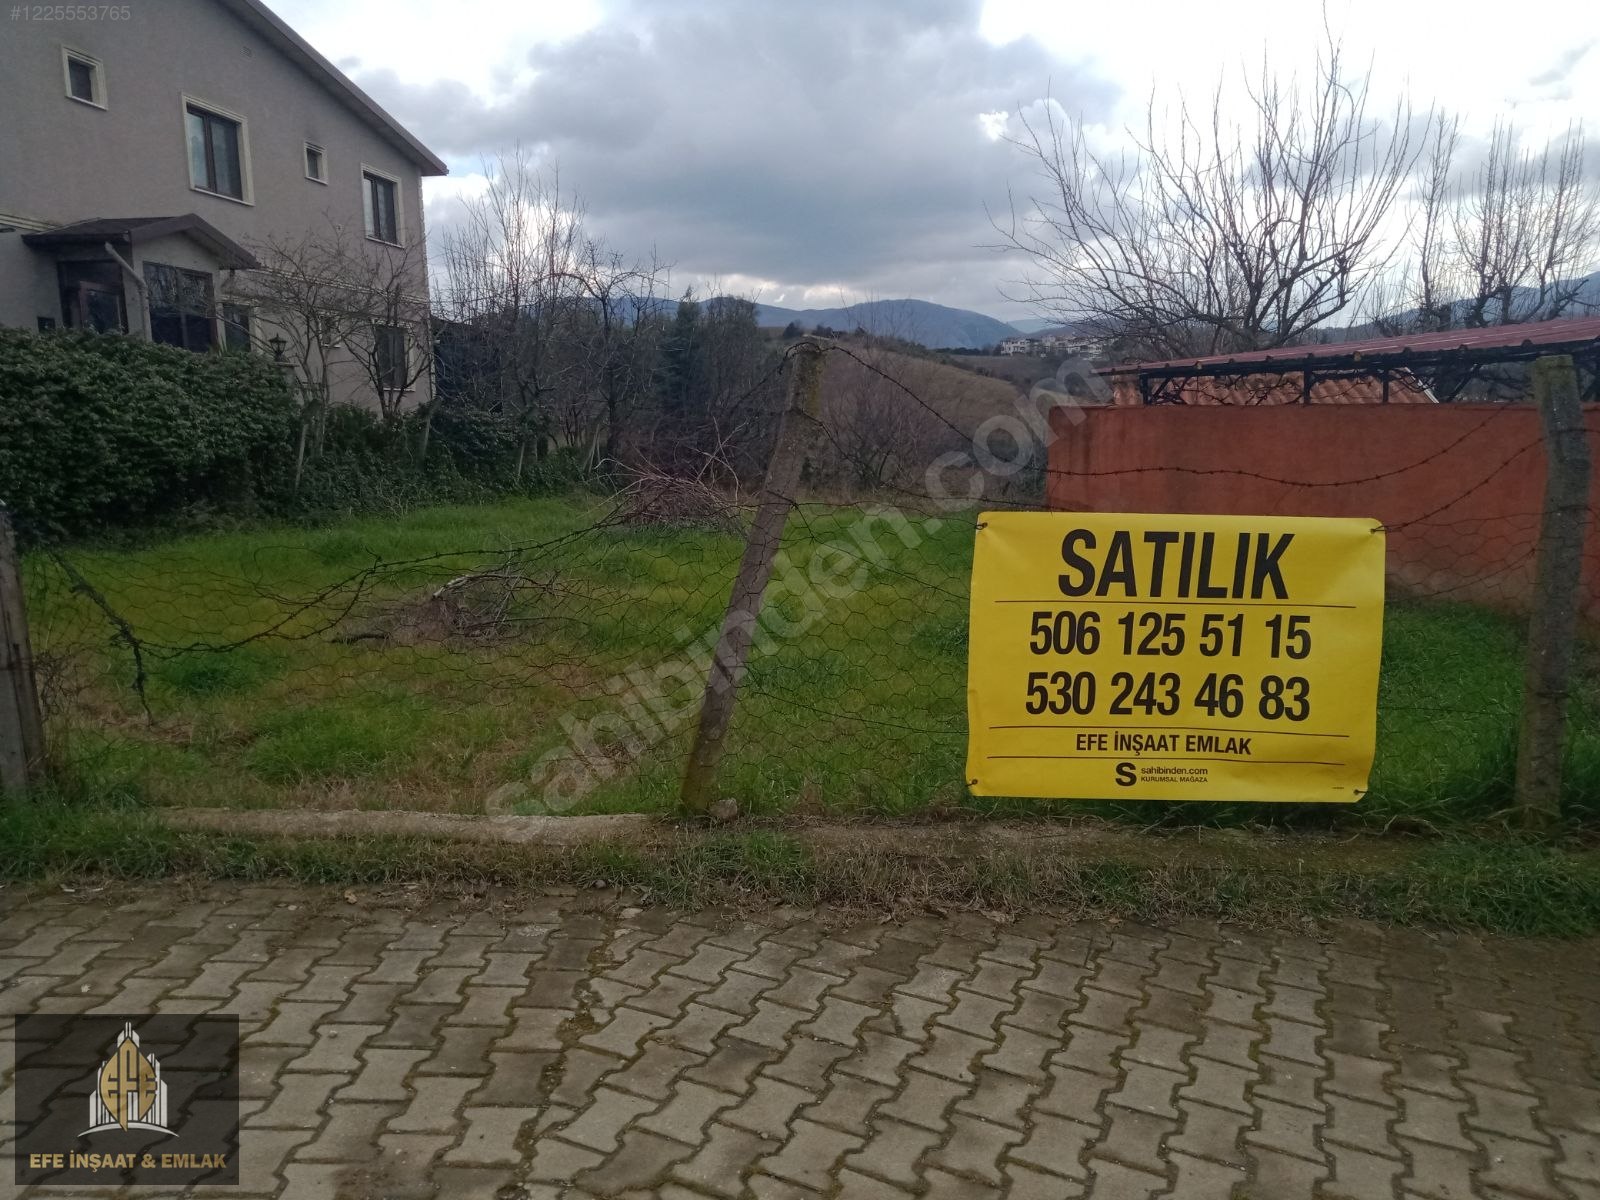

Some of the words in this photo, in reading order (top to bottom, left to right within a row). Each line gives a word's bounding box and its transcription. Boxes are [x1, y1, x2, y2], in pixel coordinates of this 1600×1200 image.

[1058, 528, 1295, 600] SATILIK
[1030, 611, 1100, 655] 506
[1117, 612, 1185, 656] 125
[1199, 613, 1244, 657] 51
[1265, 614, 1312, 660] 15
[1025, 671, 1096, 715] 530
[1109, 672, 1180, 716] 243
[1195, 673, 1244, 718] 46
[1258, 675, 1310, 721] 83
[1076, 734, 1108, 751] EFE
[1114, 731, 1180, 756] İNŞAAT
[1185, 735, 1252, 756] EMLAK
[1140, 766, 1209, 776] sahibinden.com
[1179, 775, 1209, 783] MAĞAZA
